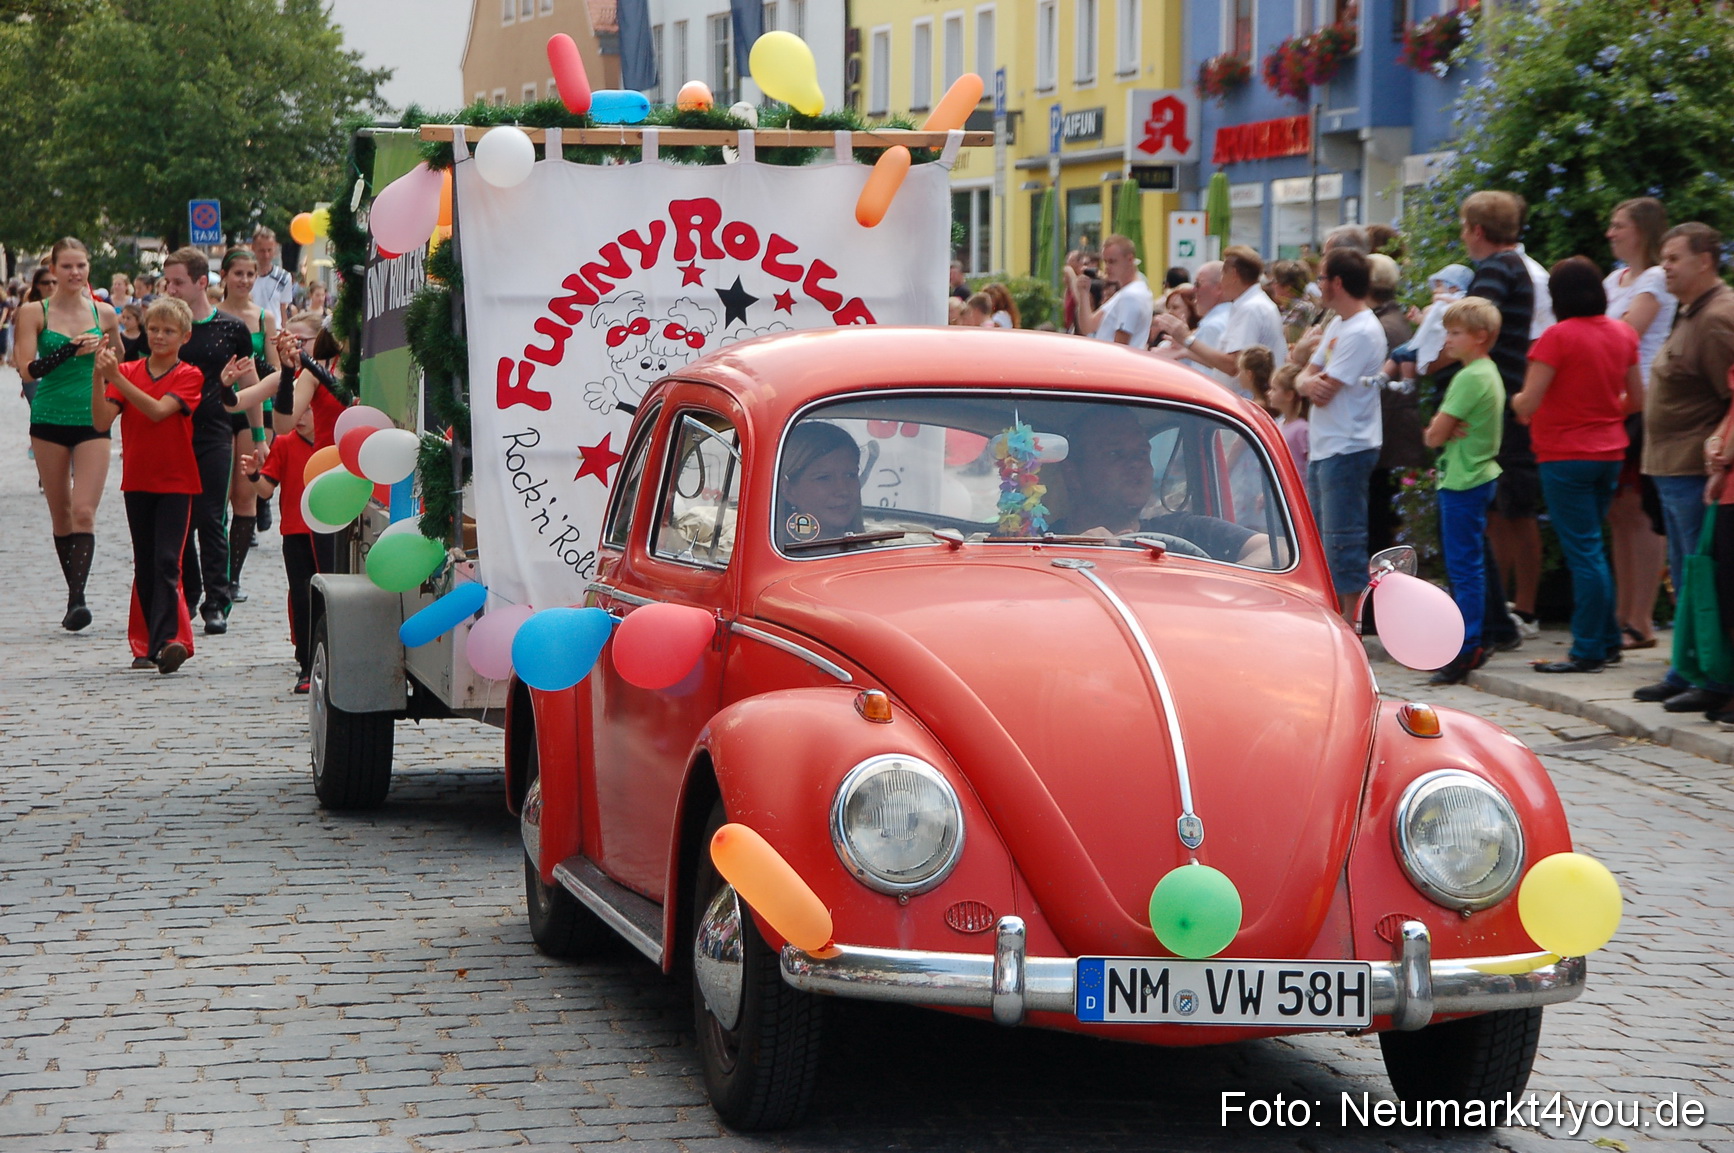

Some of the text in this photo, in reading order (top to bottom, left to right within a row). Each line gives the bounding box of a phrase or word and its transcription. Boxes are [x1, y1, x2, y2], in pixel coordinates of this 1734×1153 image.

[1062, 112, 1097, 137] AIFUN
[194, 230, 218, 241] TAXI
[1108, 967, 1366, 1018] NM VW 58H
[1085, 996, 1096, 1009] D
